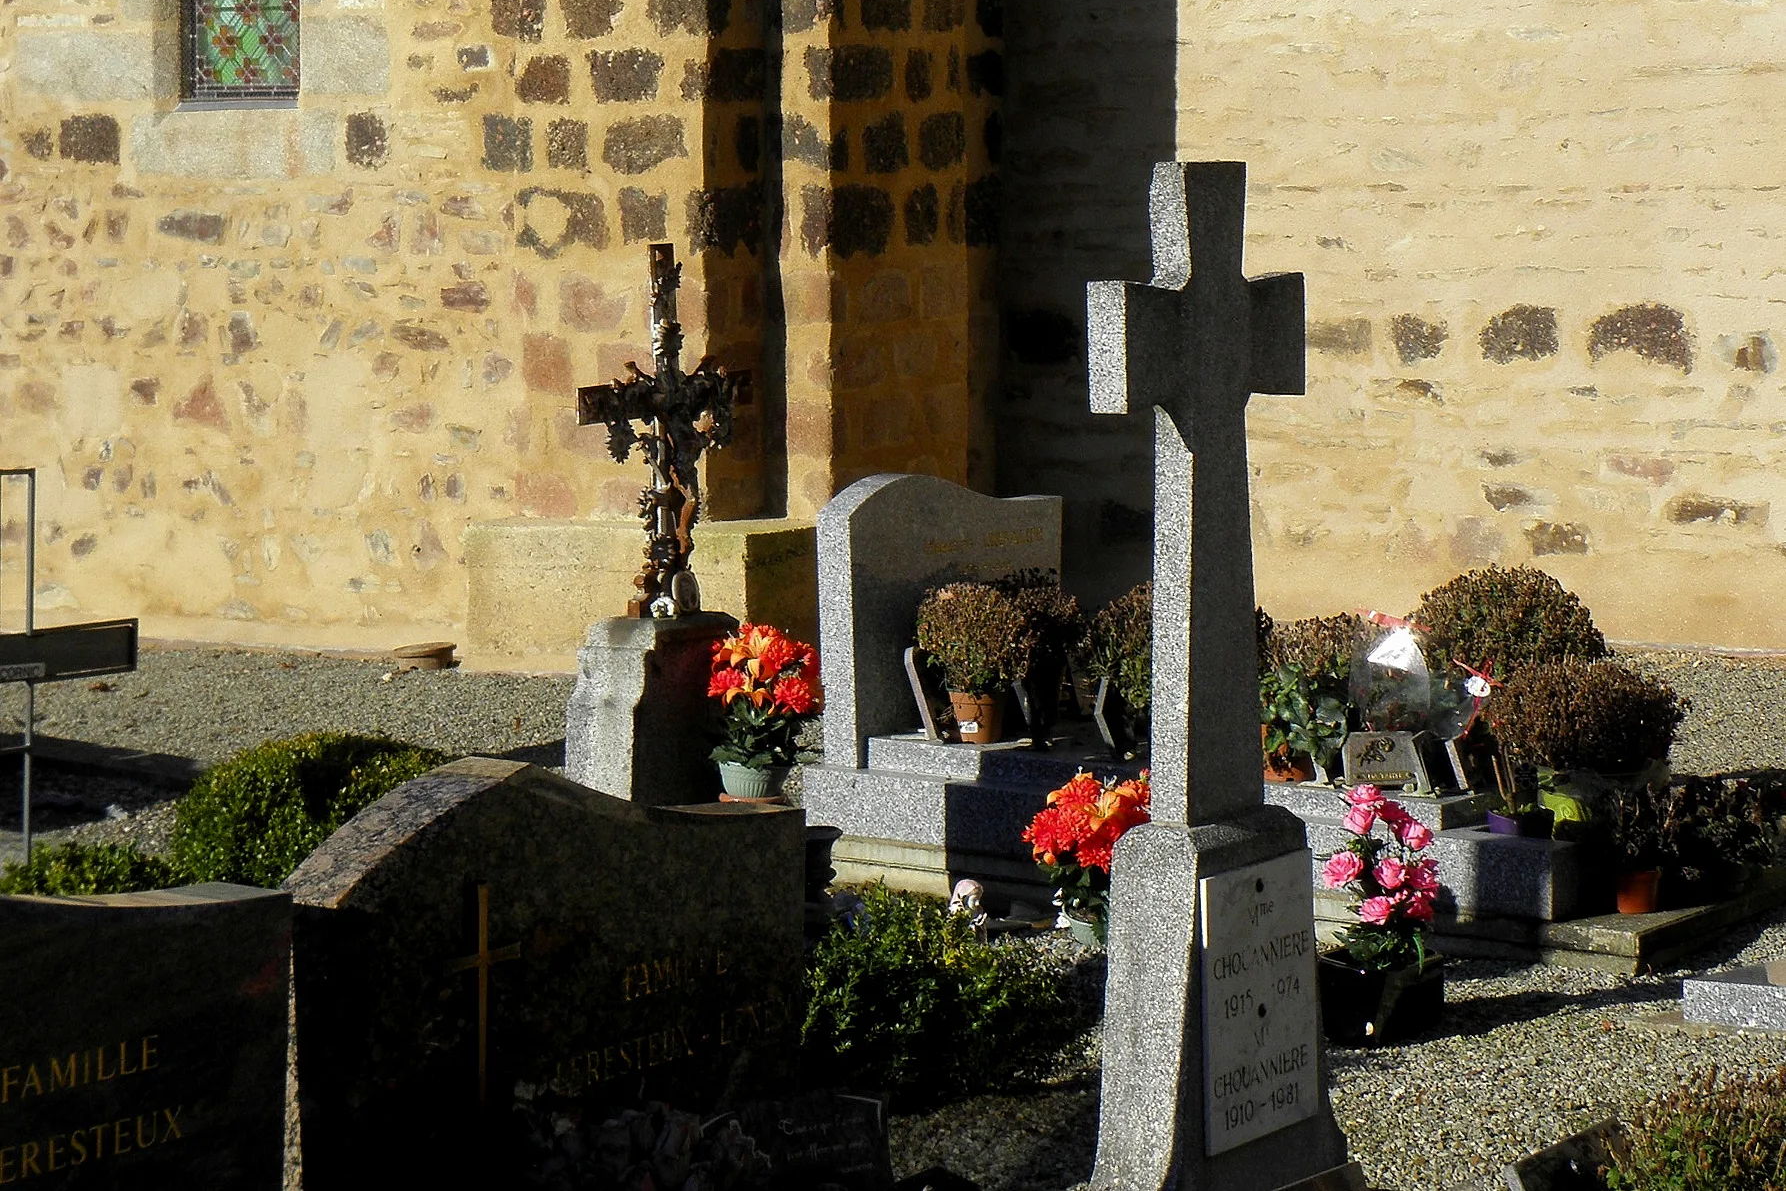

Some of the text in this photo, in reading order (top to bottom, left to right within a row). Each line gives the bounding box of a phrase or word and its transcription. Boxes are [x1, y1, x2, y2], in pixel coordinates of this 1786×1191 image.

[1224, 974, 1300, 1020] 1915 974
[0, 1033, 160, 1104] FAMILLE
[1213, 1043, 1309, 1100] CHOUANNIERE
[1224, 1100, 1254, 1132] 1910
[1270, 1080, 1300, 1113] 1981
